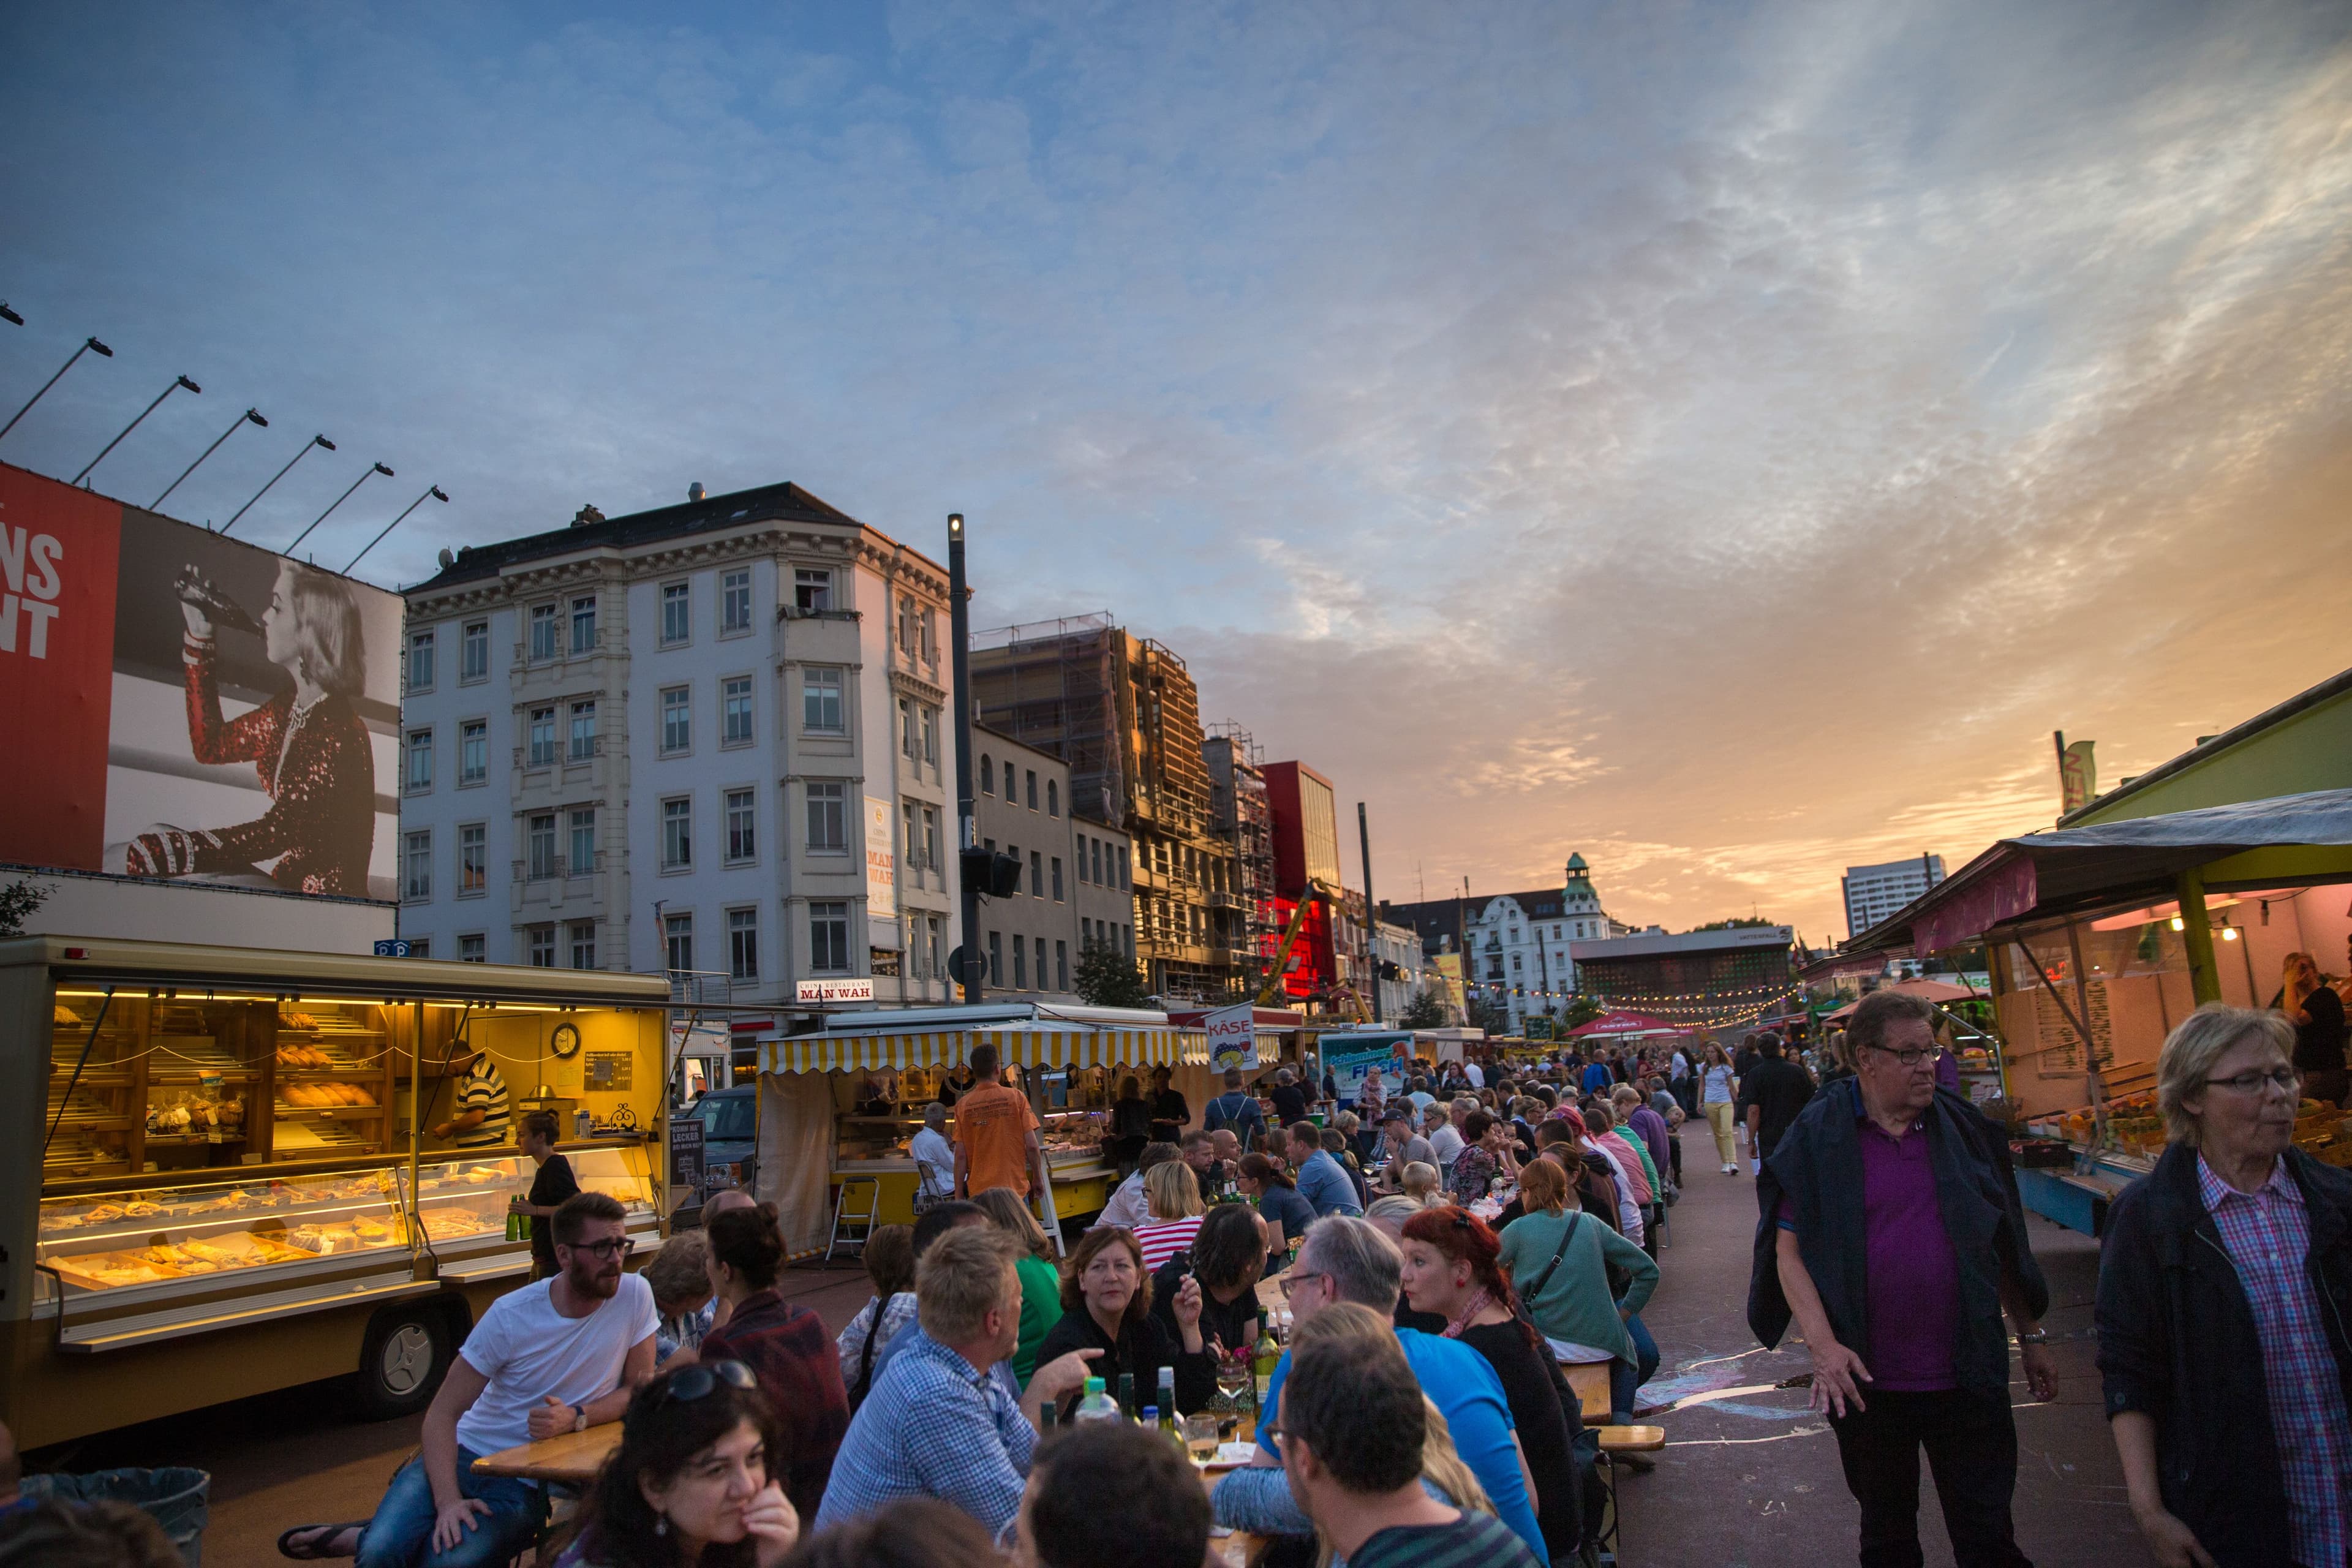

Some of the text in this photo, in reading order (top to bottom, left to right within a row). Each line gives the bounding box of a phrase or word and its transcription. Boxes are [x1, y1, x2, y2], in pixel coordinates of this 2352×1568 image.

[867, 850, 893, 869] MAN
[869, 867, 894, 886] WAH
[397, 946, 405, 957] P
[801, 988, 870, 999] MAN WAH
[1208, 1020, 1251, 1037] KÄSE
[673, 1132, 699, 1143] LECKER
